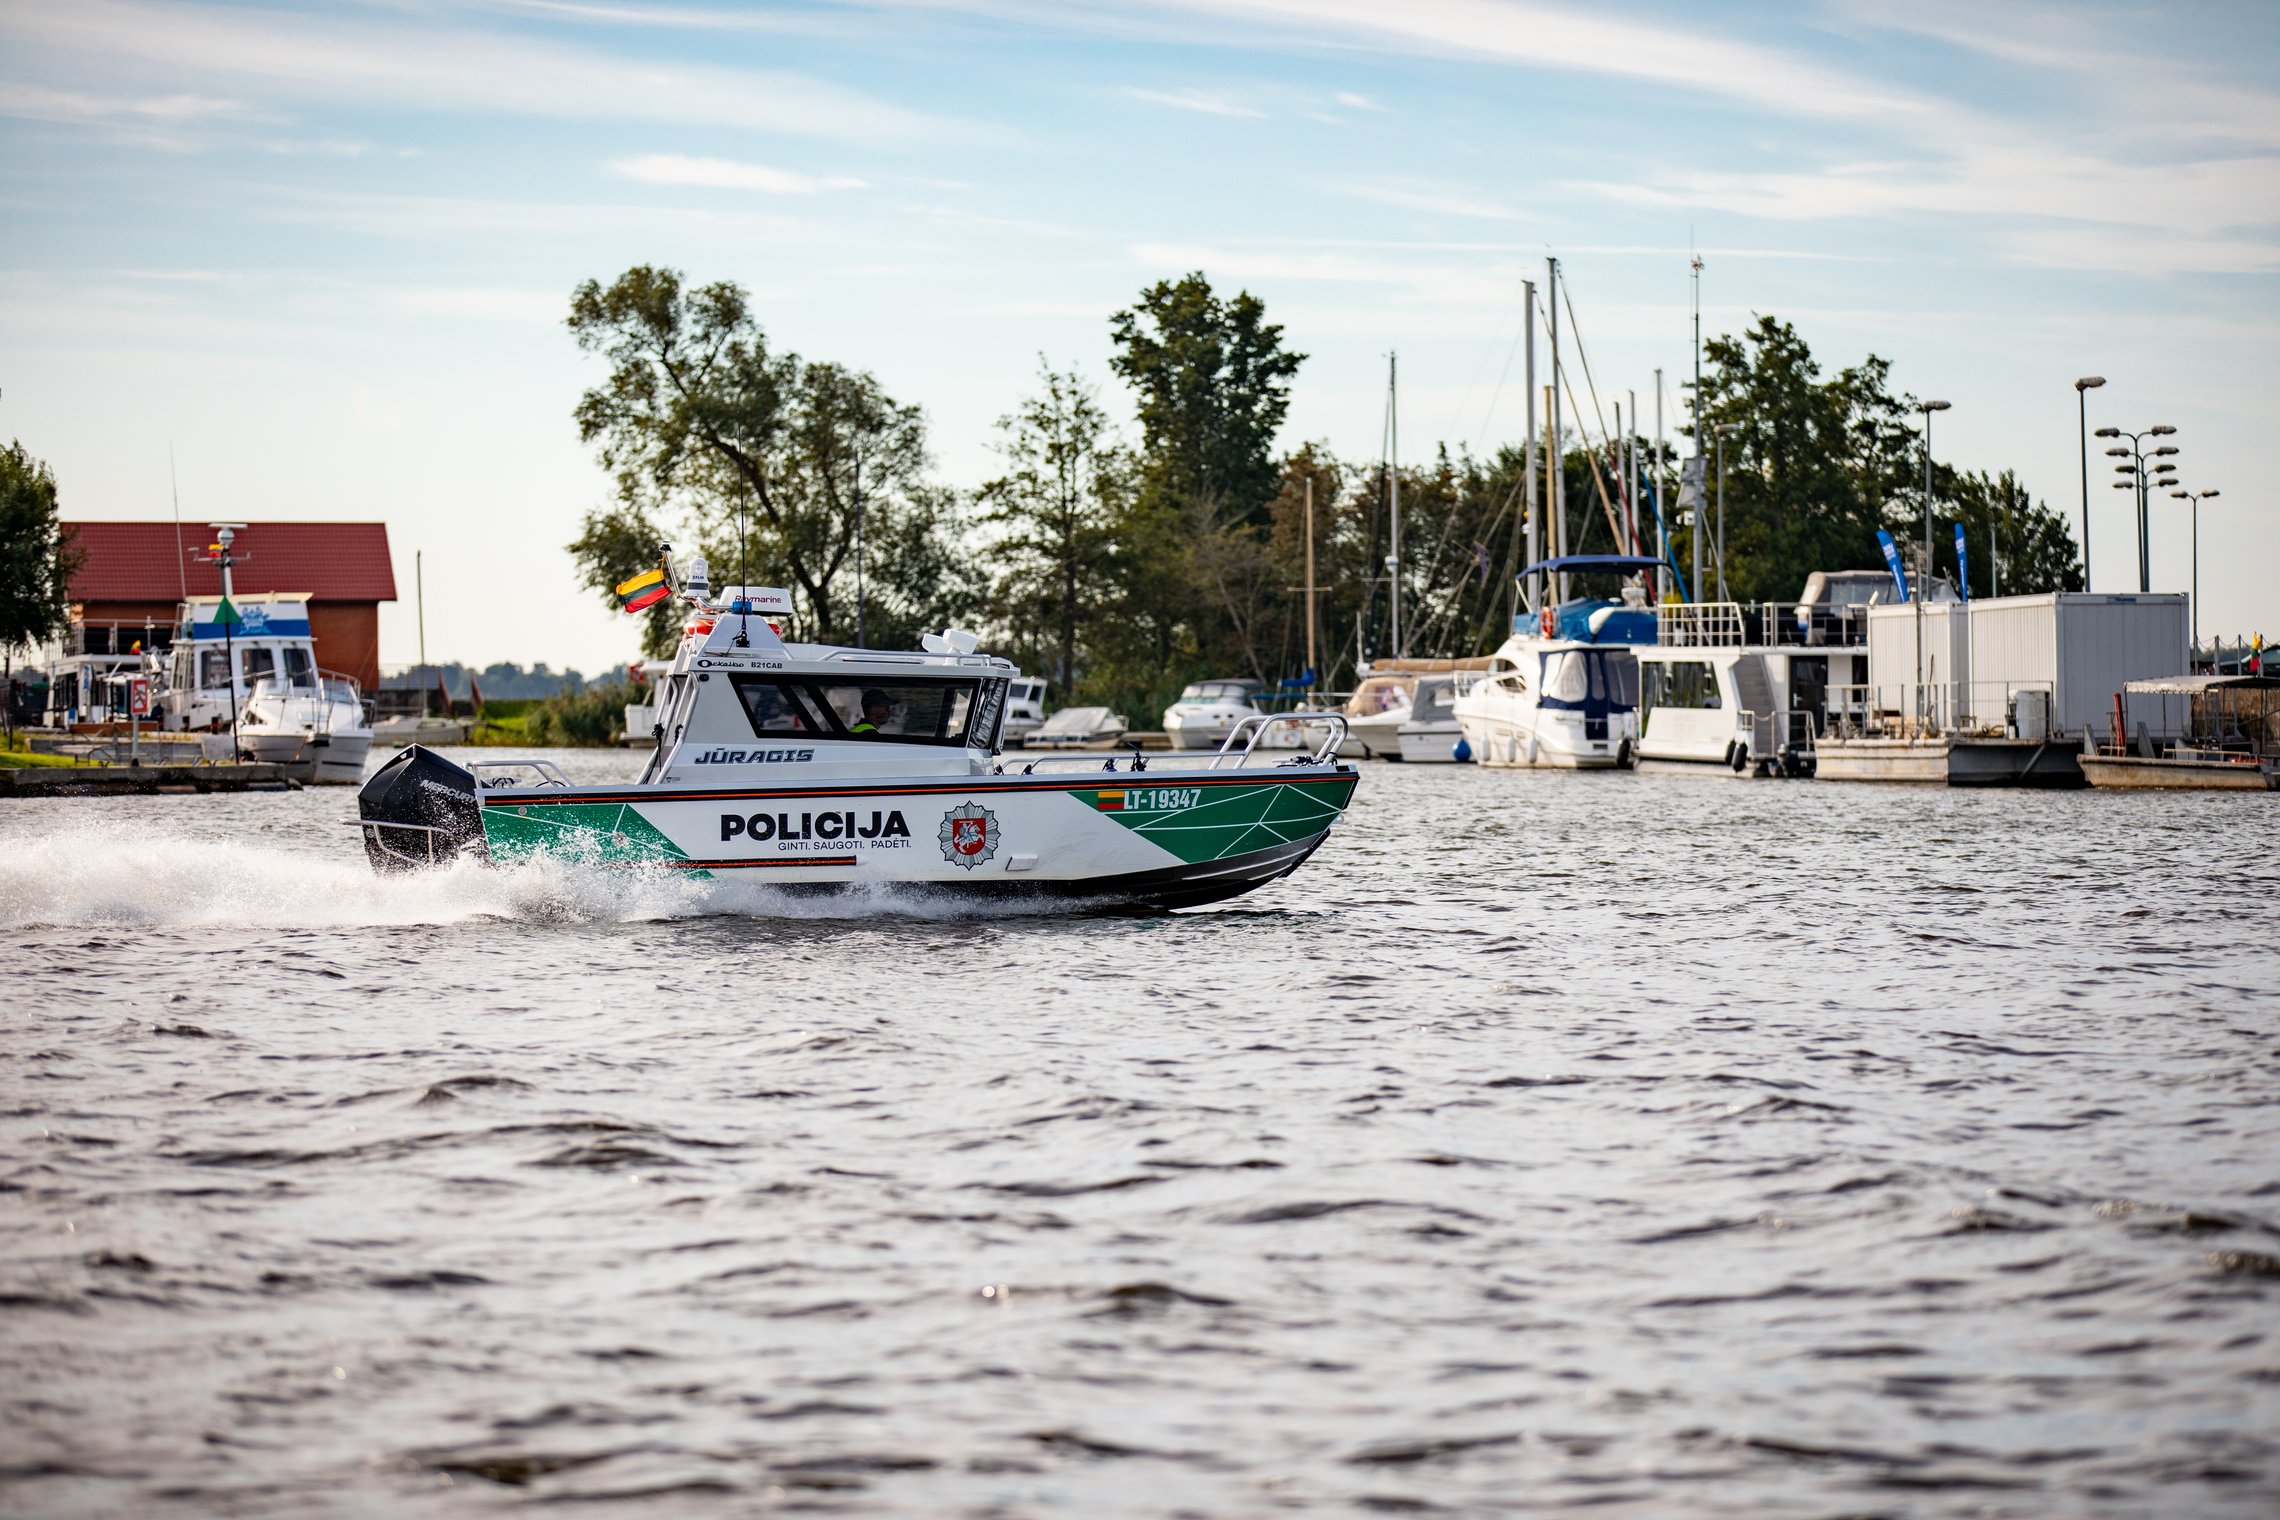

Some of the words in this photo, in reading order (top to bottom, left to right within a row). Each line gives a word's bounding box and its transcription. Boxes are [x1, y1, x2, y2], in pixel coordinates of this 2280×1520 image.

[735, 595, 782, 604] Rymarine
[751, 661, 783, 669] B21CAB
[694, 747, 815, 764] JŪRAGIS
[420, 779, 476, 803] MERCURY
[1123, 788, 1202, 810] LT-19347
[720, 810, 912, 842] POLICIJA
[778, 841, 811, 851] GINTI.
[813, 840, 865, 850] SAUGOTI.
[871, 838, 912, 849] PADĖTI.
